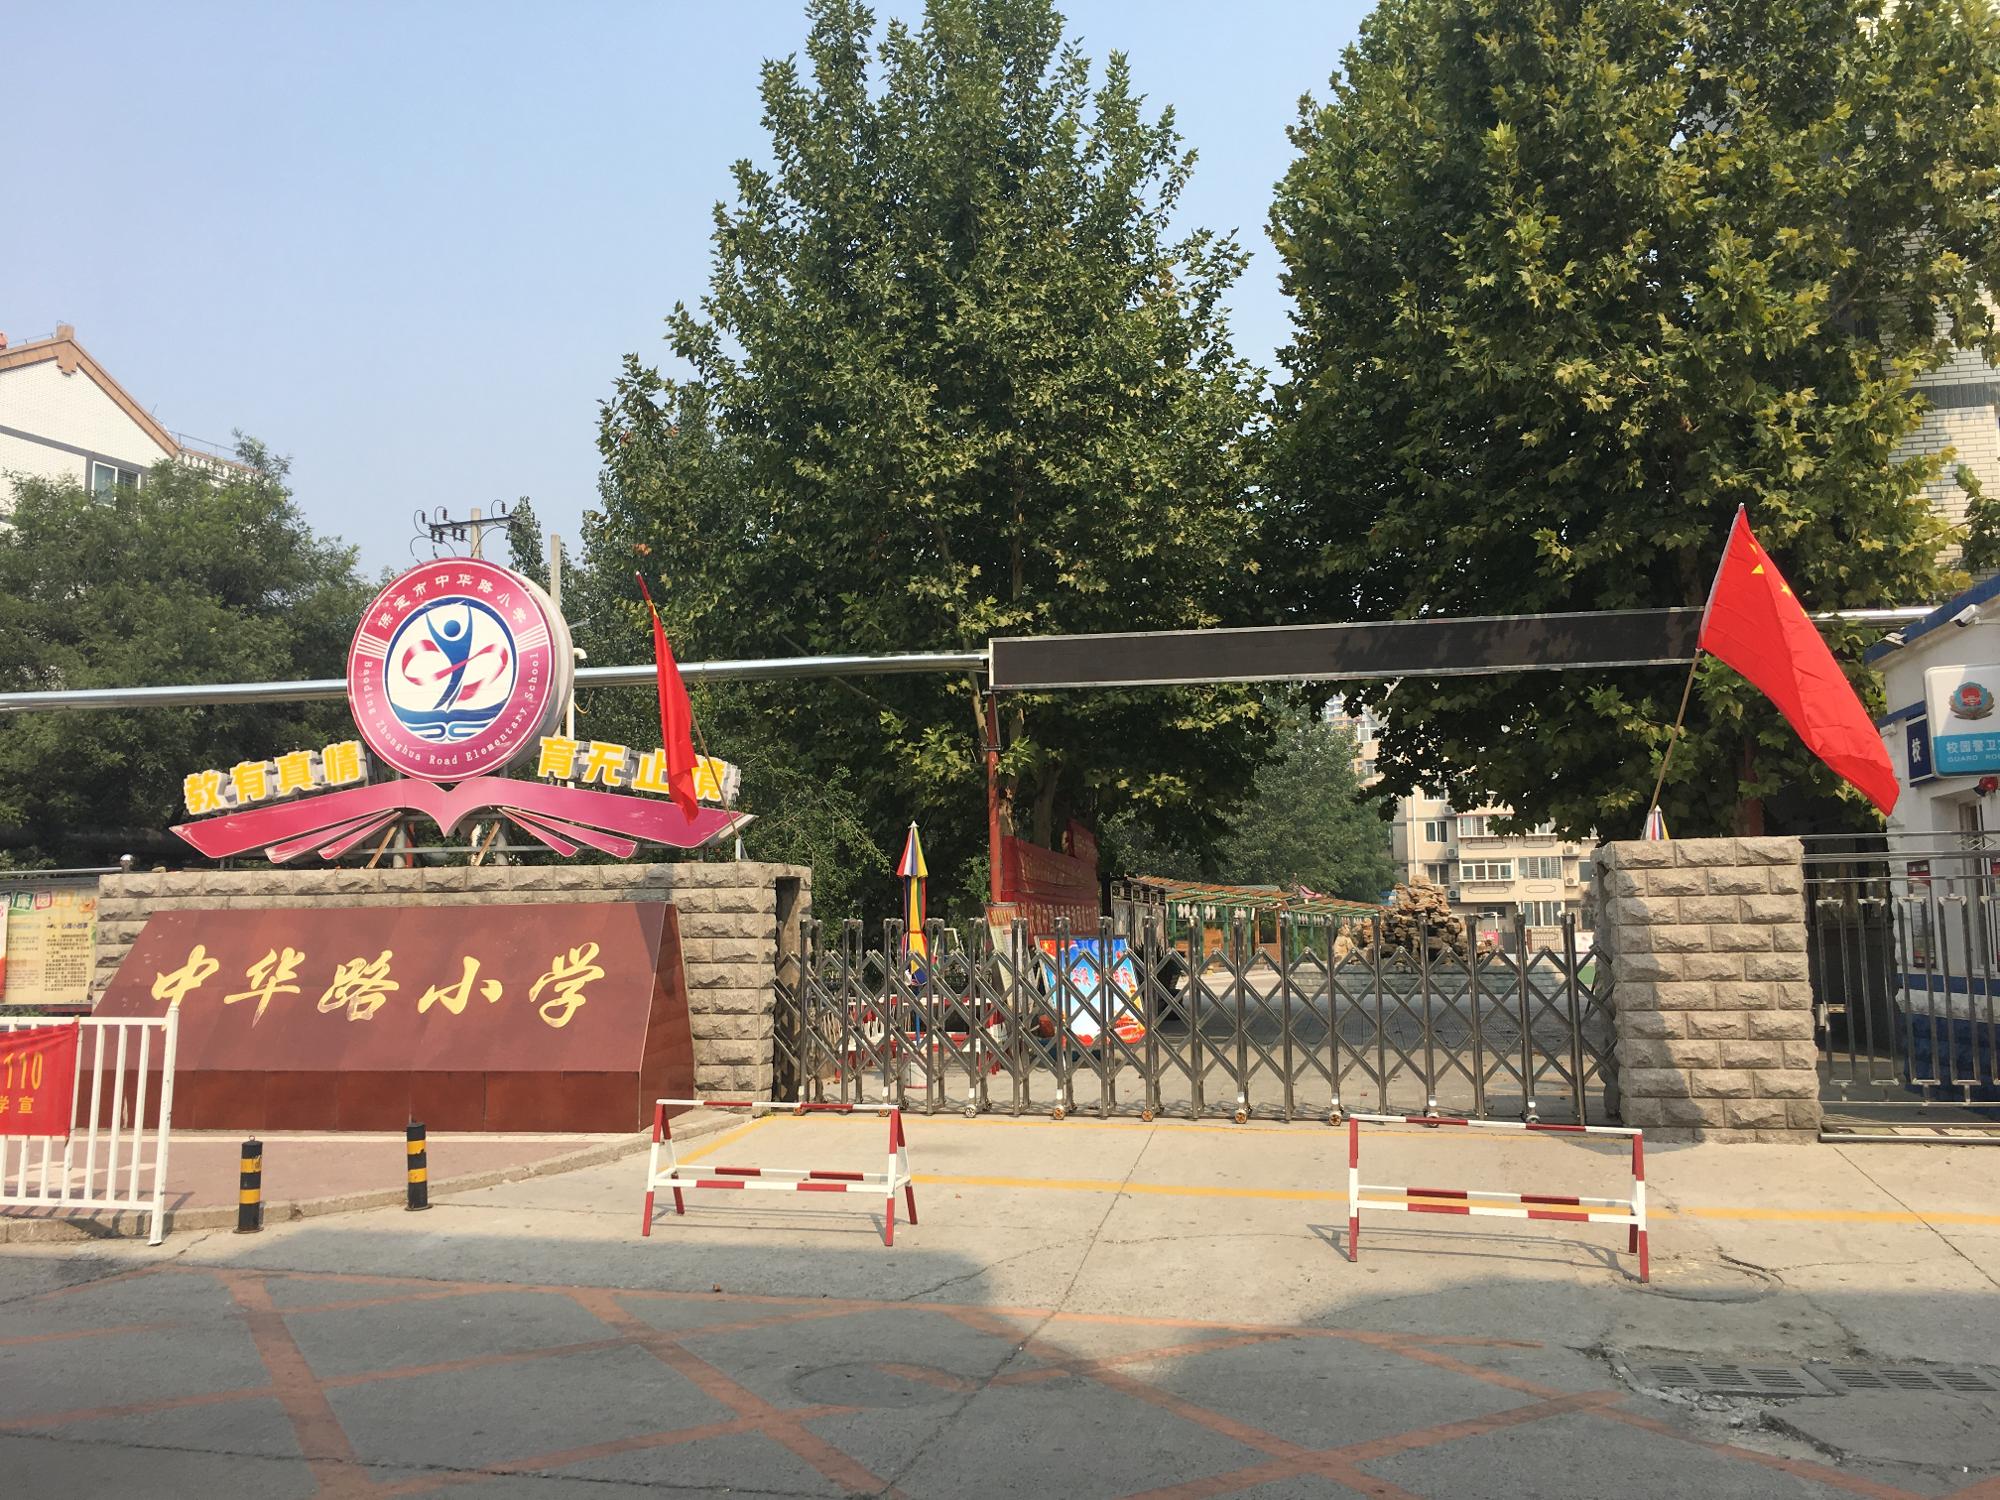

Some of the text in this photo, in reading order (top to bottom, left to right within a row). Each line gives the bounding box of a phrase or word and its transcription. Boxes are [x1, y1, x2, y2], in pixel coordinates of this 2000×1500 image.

[378, 572, 527, 629] 保定市中华路小学
[363, 652, 540, 765] Baoding Zhonghua Road Elementary School
[184, 740, 362, 815] 教有真情
[151, 942, 605, 1032] 中华路小学
[3, 1051, 43, 1090] 110
